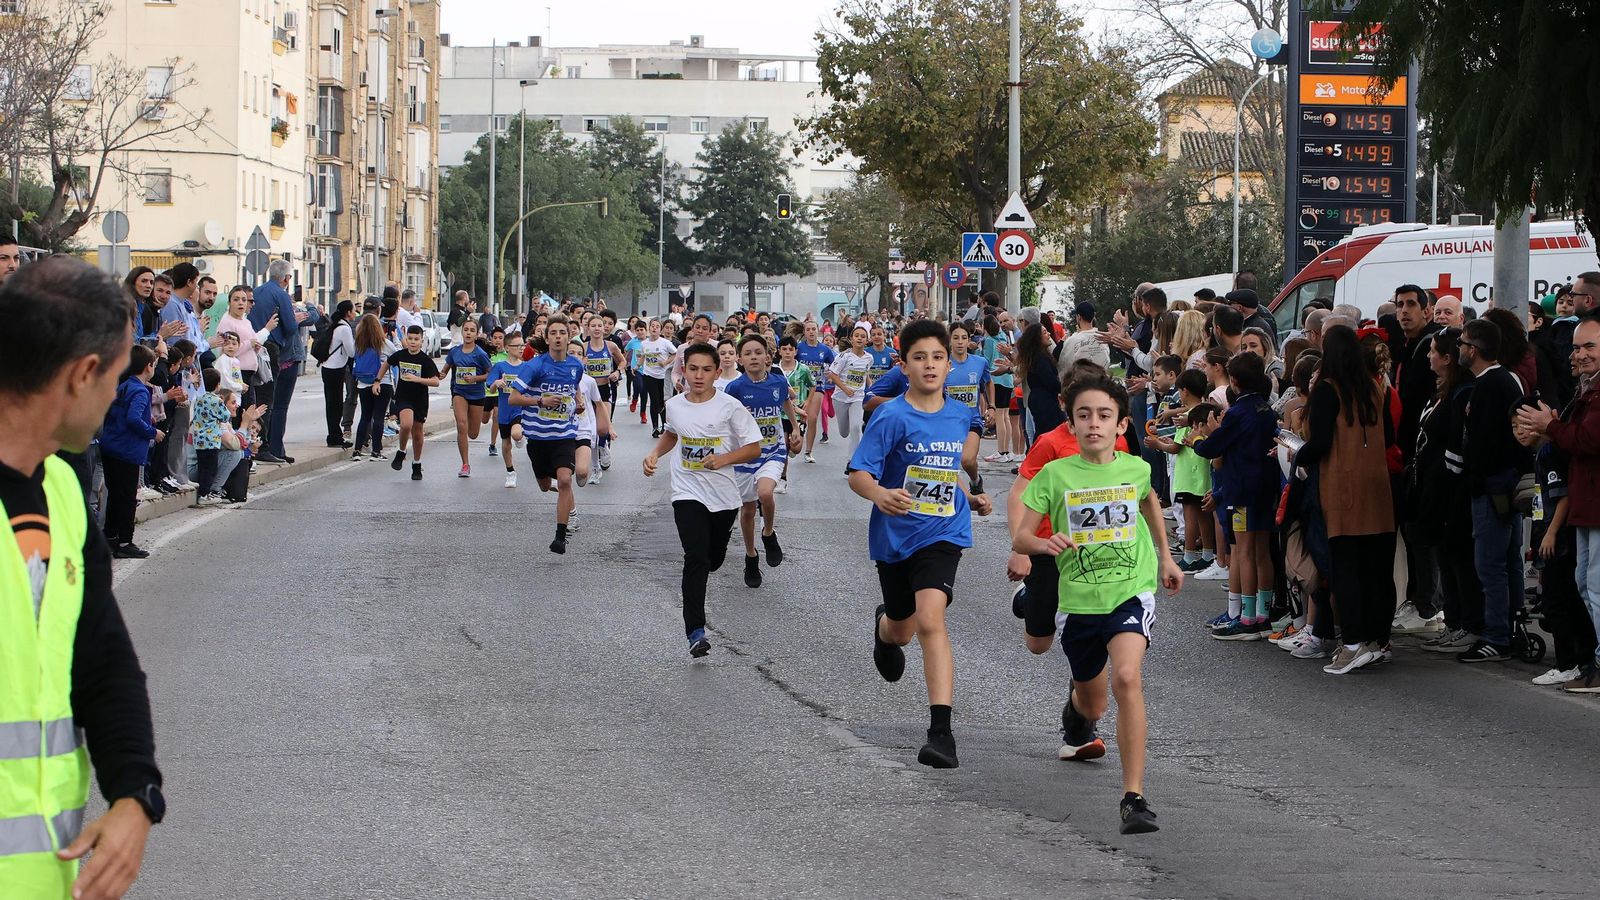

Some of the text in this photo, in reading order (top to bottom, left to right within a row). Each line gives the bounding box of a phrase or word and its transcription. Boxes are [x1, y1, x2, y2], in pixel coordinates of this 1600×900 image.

[1342, 86, 1365, 95] Moto
[1303, 113, 1322, 121] Diesel
[1346, 114, 1391, 130] 1.459
[1333, 144, 1342, 156] 5
[1345, 146, 1391, 161] 1.499
[1302, 176, 1321, 184] Diesel
[1345, 177, 1391, 192] 1.549
[1327, 209, 1339, 218] 95
[1004, 243, 1025, 256] 30
[1421, 240, 1495, 256] AMBULAN
[952, 392, 974, 402] 780
[760, 425, 776, 437] 09
[905, 442, 929, 452] C.A.
[920, 455, 954, 467] JEREZ
[915, 481, 954, 502] 745
[1070, 490, 1092, 499] CARRERA
[1081, 496, 1107, 504] BOMBEROS
[1080, 504, 1130, 528] 213
